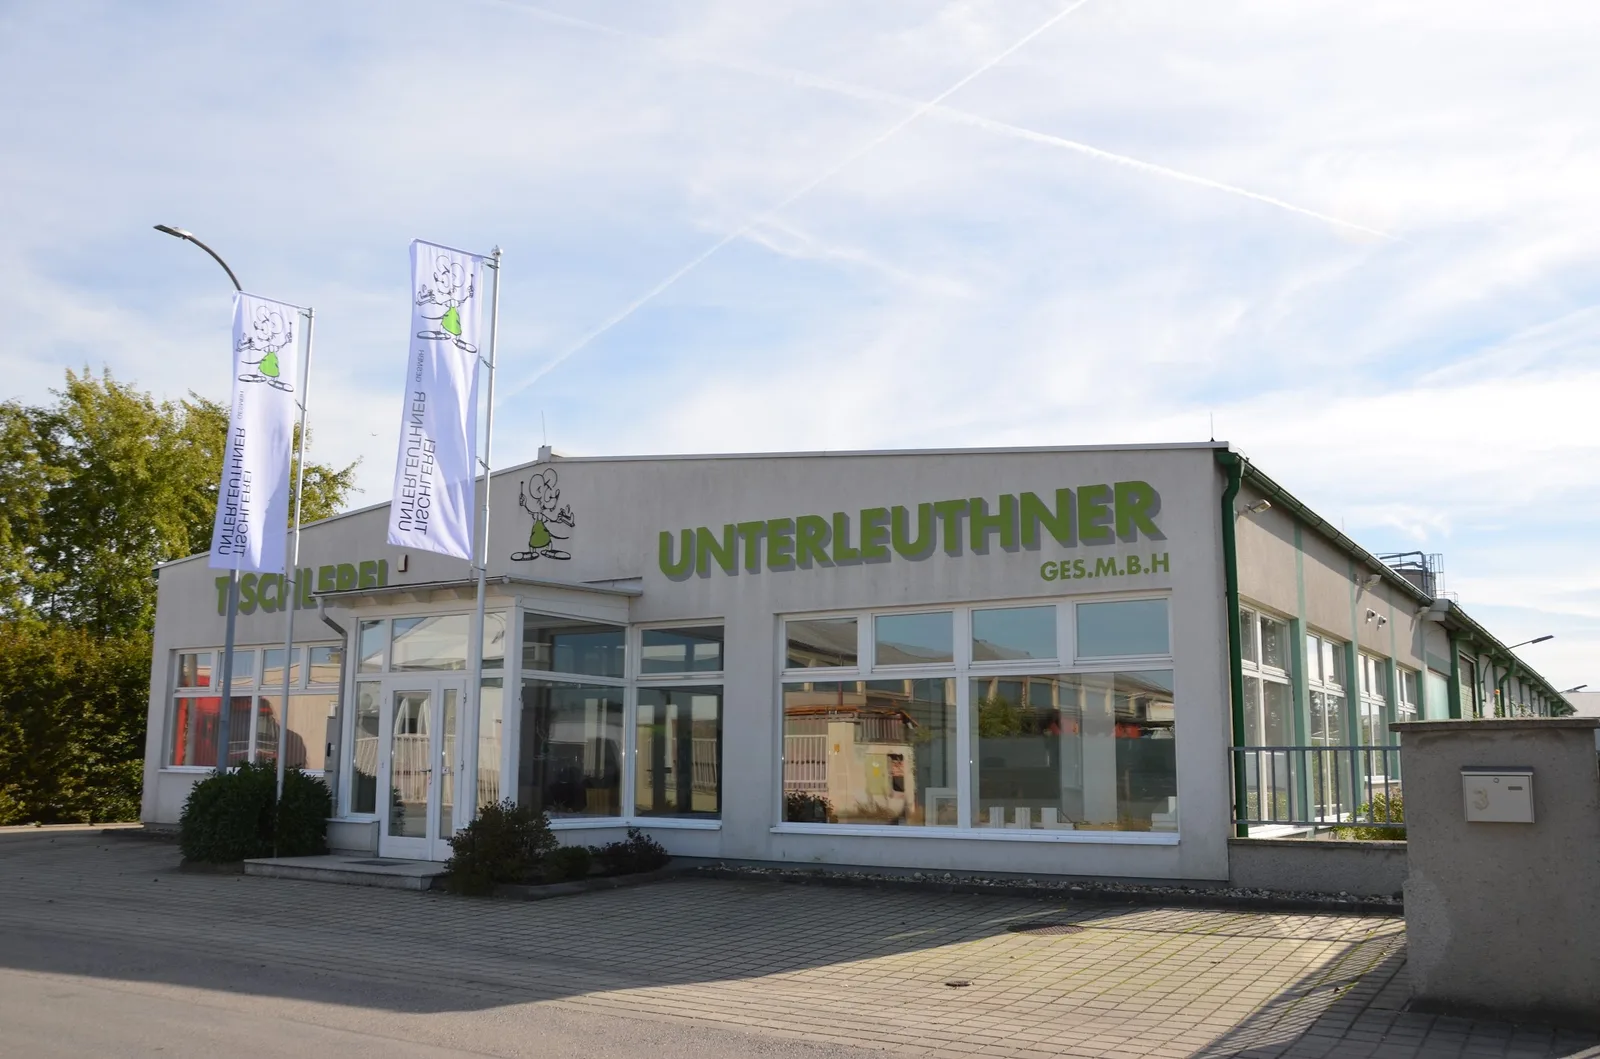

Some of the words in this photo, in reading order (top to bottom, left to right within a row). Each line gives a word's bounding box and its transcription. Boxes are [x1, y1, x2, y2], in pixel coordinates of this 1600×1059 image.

[658, 480, 1168, 582] UNTERLEUTHNER
[215, 558, 389, 617] TSCHLEREI
[1040, 552, 1169, 581] GES.M.B.H
